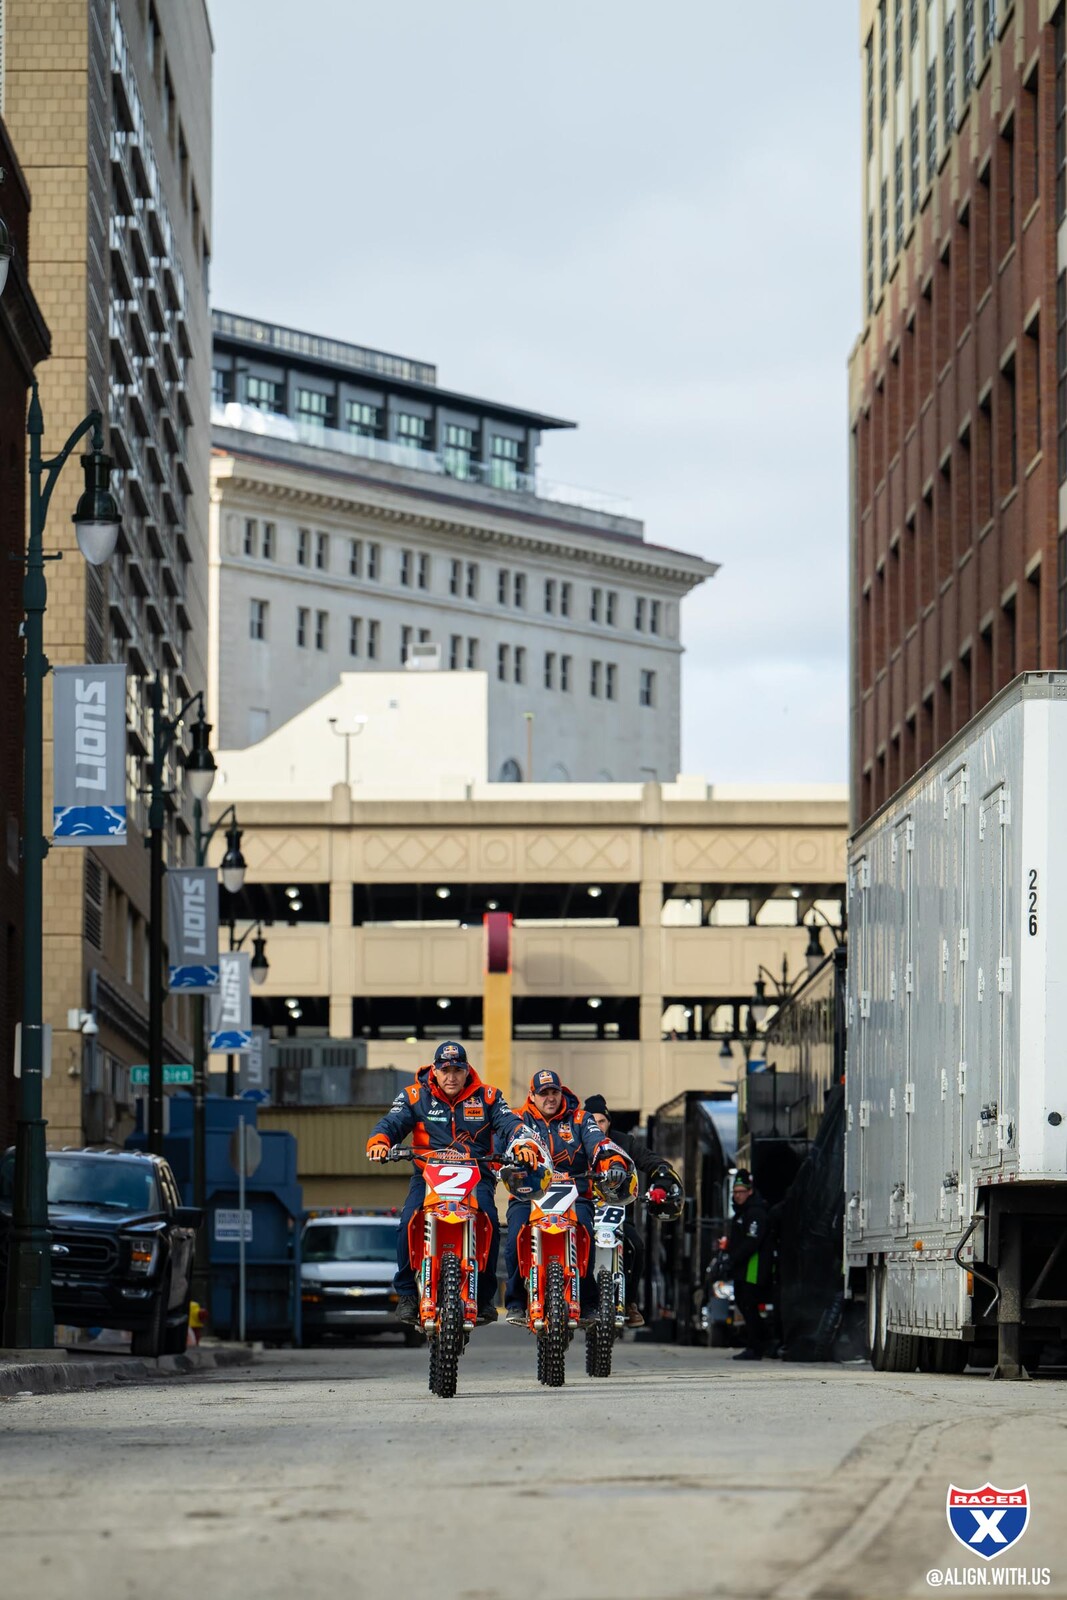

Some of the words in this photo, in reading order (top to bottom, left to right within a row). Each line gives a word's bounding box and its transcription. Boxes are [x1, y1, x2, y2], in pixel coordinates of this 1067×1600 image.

[75, 678, 107, 792] LIONS
[183, 876, 206, 956] LIONS
[1029, 868, 1038, 936] 226
[135, 1068, 189, 1081] Bebien
[433, 1166, 473, 1195] 2
[540, 1185, 573, 1210] 7
[468, 1260, 476, 1293] DUNLP
